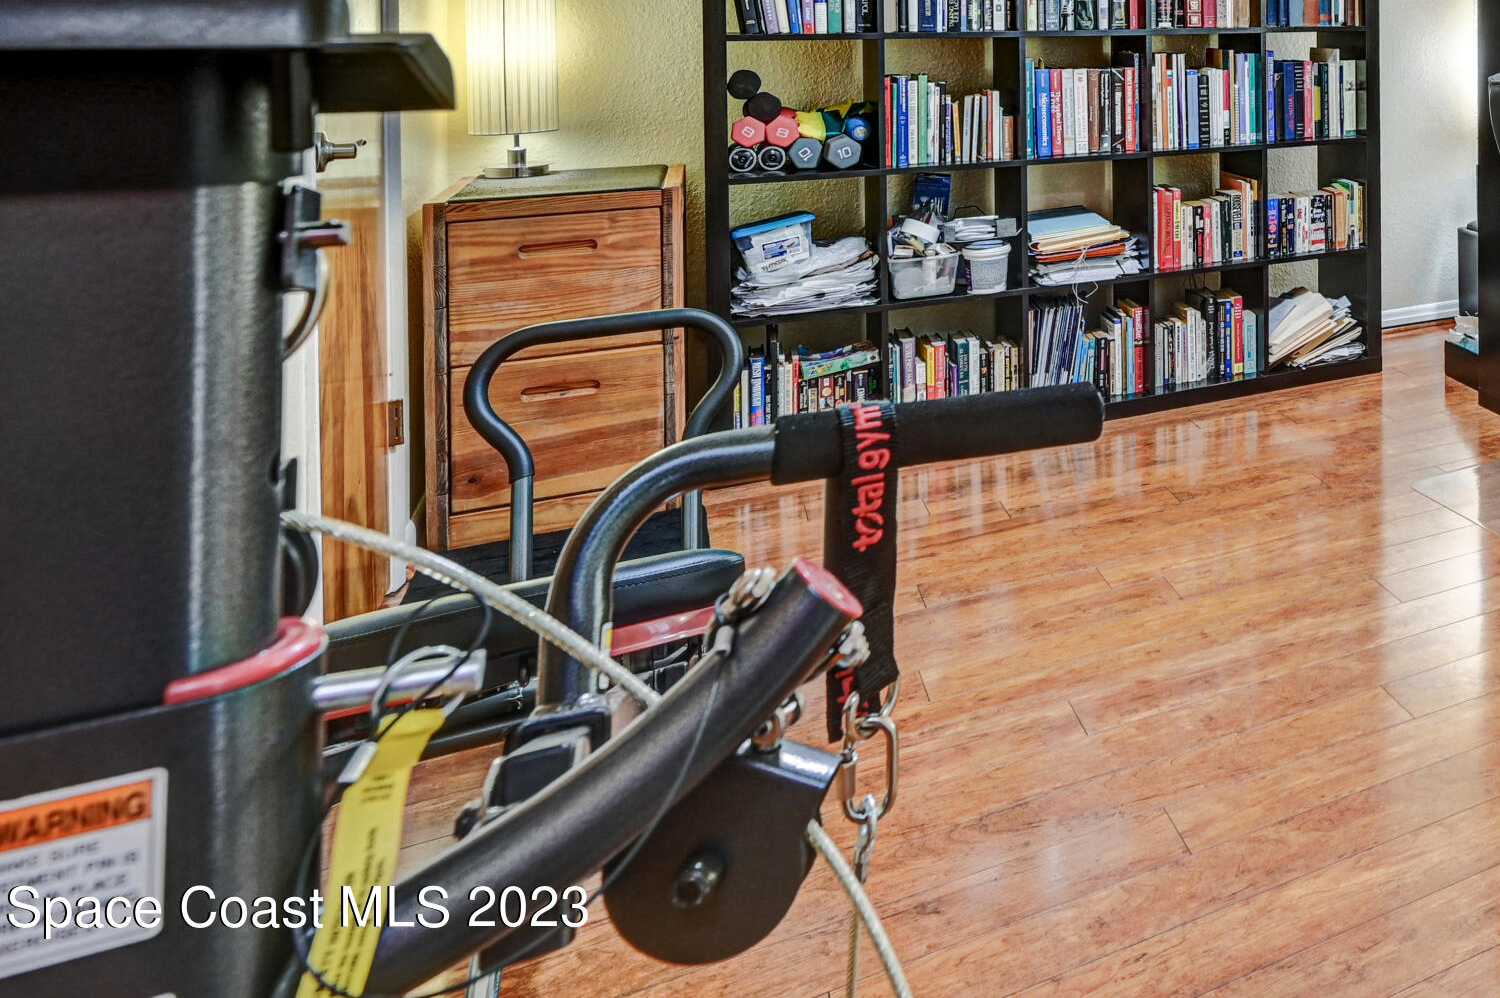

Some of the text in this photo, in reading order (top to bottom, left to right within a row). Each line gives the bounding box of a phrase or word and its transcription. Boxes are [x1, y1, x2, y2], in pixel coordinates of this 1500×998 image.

[1041, 93, 1049, 146] Microeconomics
[740, 125, 756, 139] 8
[775, 126, 790, 139] 8
[798, 146, 814, 162] 10
[836, 145, 852, 161] 10
[1232, 194, 1241, 222] ROOSEVELT
[752, 362, 762, 406] RUSH LIMBAUGH
[850, 405, 891, 552] total gym
